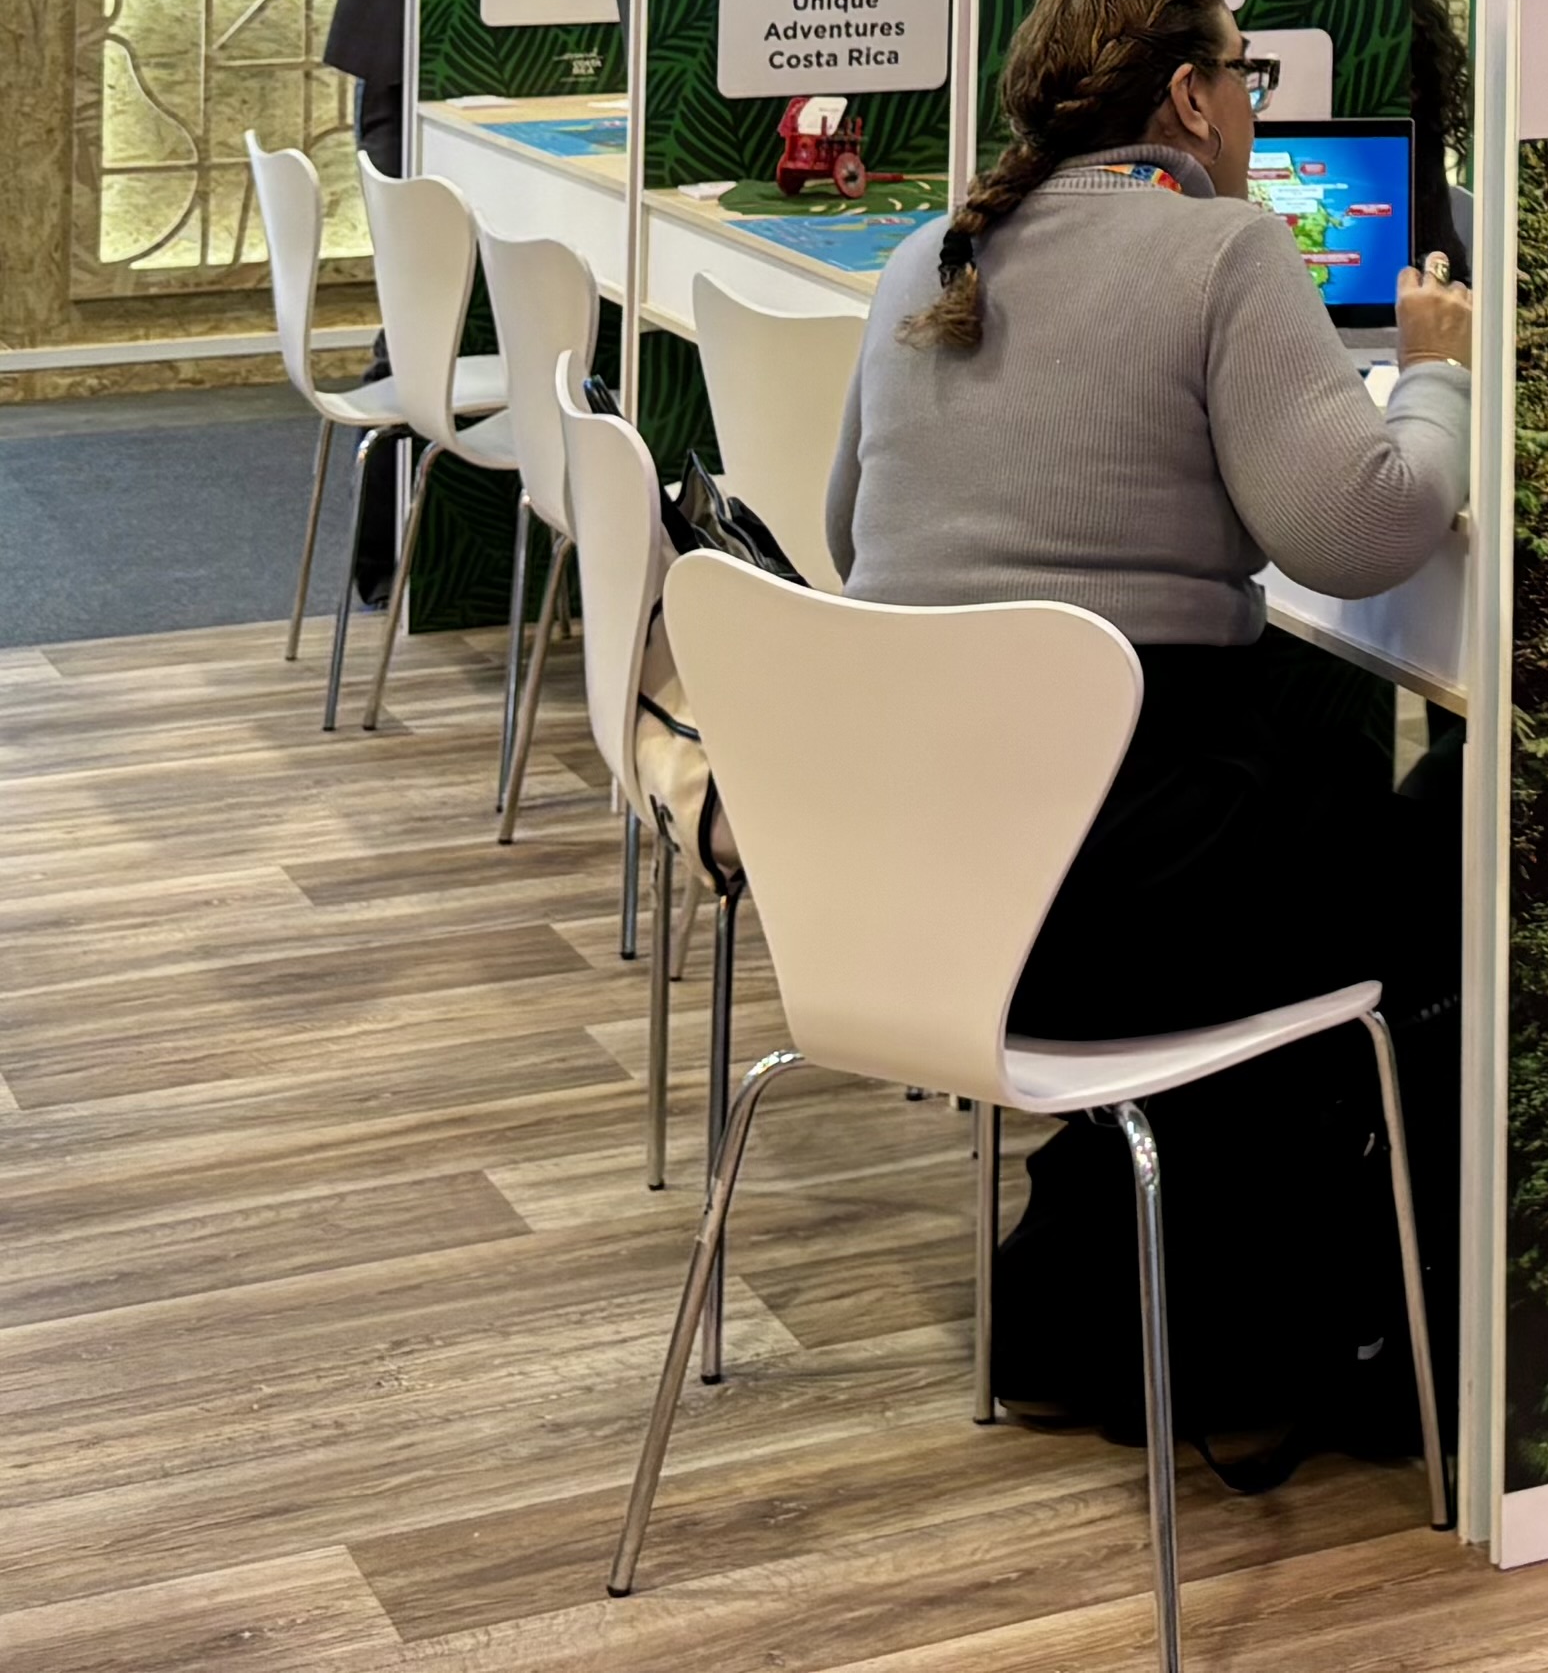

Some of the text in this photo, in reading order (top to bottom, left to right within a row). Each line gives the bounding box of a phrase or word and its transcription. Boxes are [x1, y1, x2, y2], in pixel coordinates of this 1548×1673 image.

[764, 19, 906, 42] Adventures
[768, 46, 901, 71] Costa Rica
